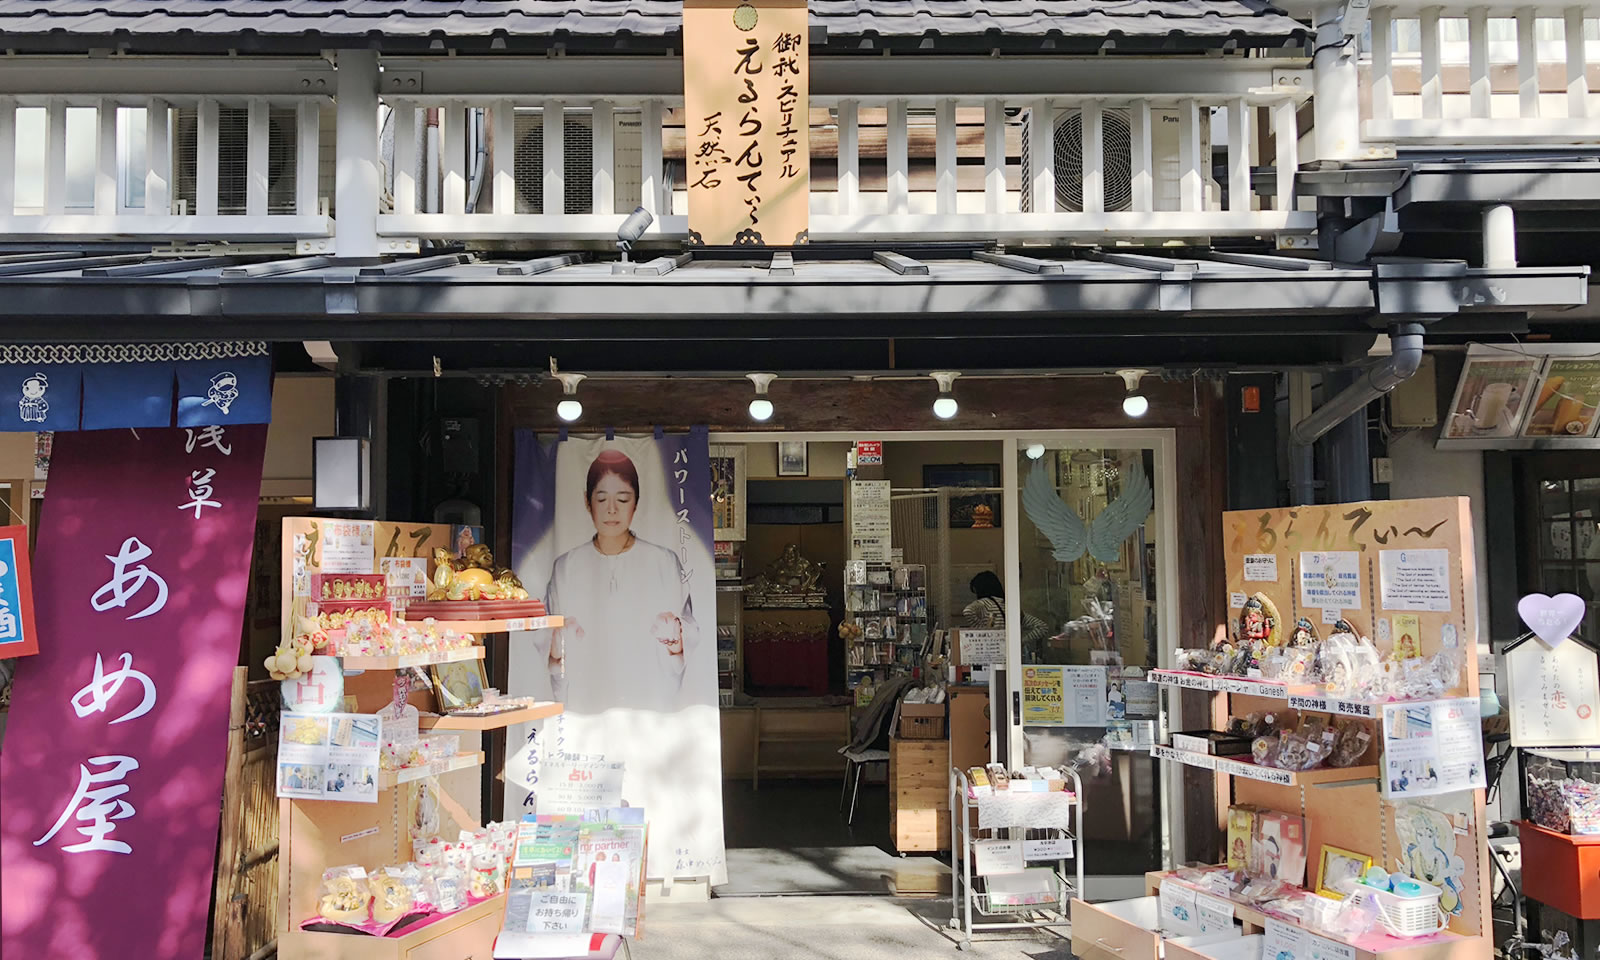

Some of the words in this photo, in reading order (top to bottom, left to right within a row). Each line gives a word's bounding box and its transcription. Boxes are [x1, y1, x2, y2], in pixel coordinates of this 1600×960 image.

[691, 112, 731, 189] 天然石
[178, 425, 231, 519] 浅草
[674, 448, 693, 584] パワーストーン
[33, 537, 168, 854] あめ屋
[1259, 685, 1285, 697] Ganesh
[1290, 697, 1327, 711] 学問の神様
[1337, 701, 1371, 715] 商売繁盛
[568, 768, 592, 781] 占い
[594, 841, 629, 852] partner
[540, 895, 577, 904] ご自由に
[535, 907, 579, 918] お持ち帰り
[542, 921, 568, 930] 下さい
